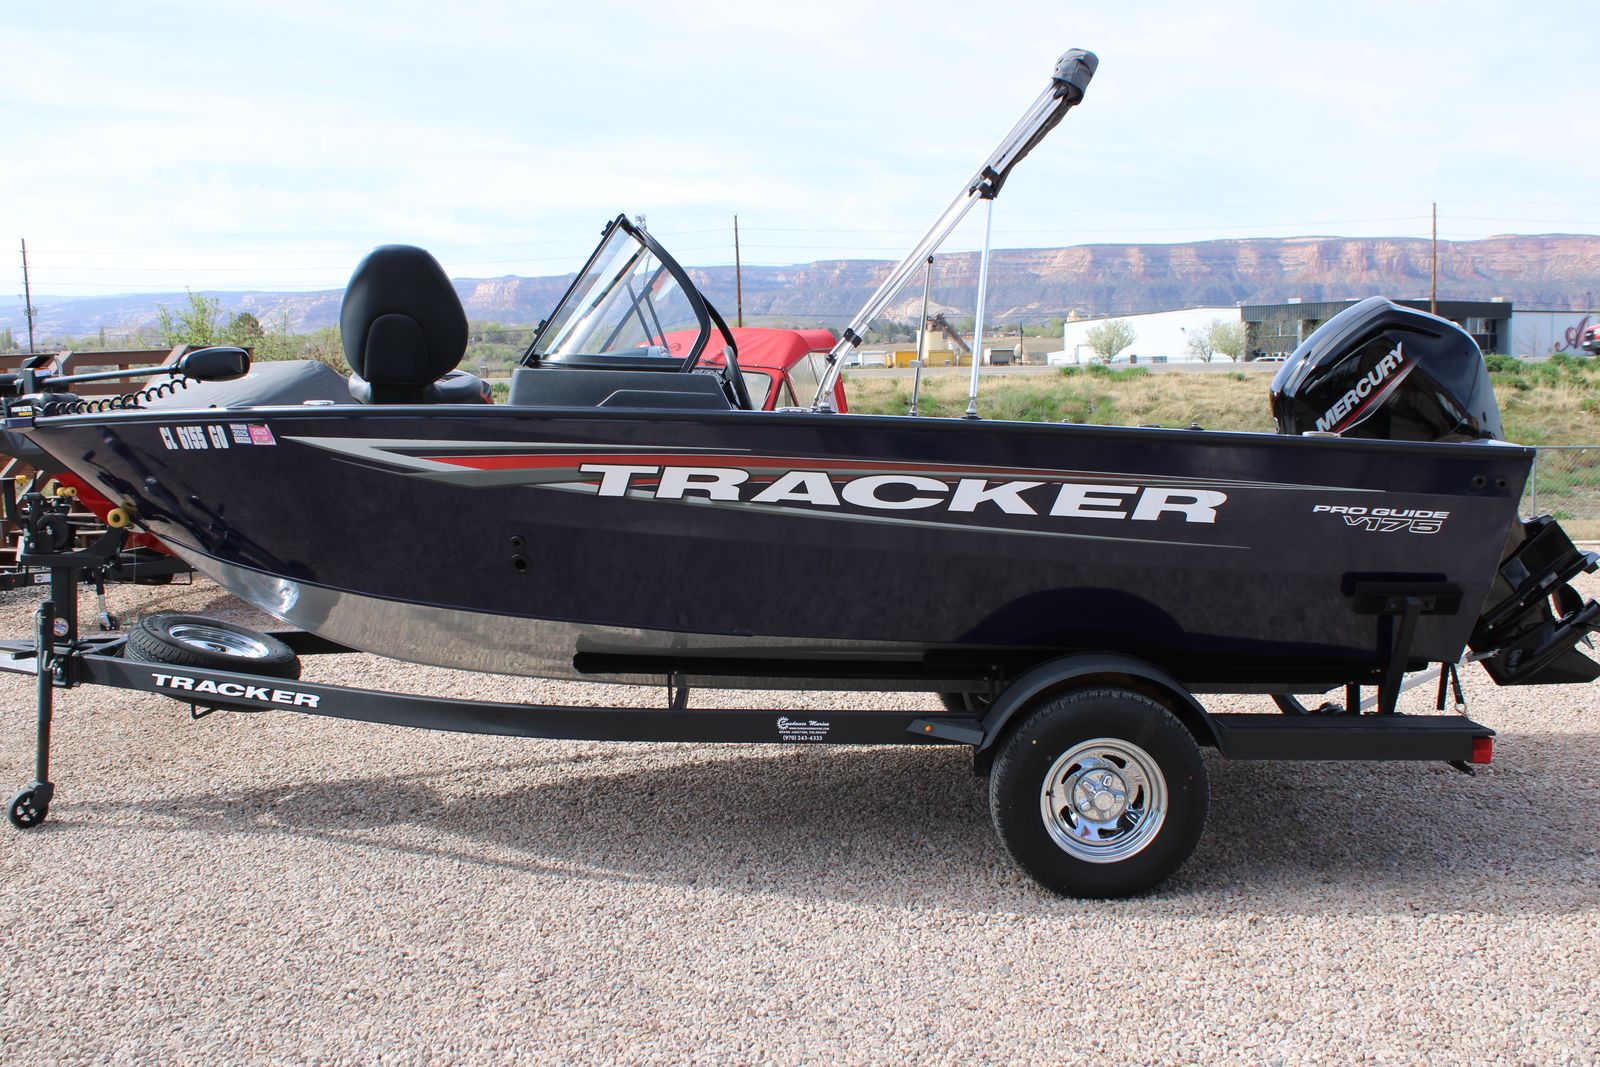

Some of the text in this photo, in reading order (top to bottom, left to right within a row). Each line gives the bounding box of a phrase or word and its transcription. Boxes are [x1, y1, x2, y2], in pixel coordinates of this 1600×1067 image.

[1314, 341, 1405, 432] MERCURY
[159, 427, 179, 450] CL
[580, 463, 1228, 524] TRACKER
[1312, 504, 1450, 519] PRO GUIDE
[1343, 515, 1443, 534] V175
[152, 673, 321, 708] TRACKER
